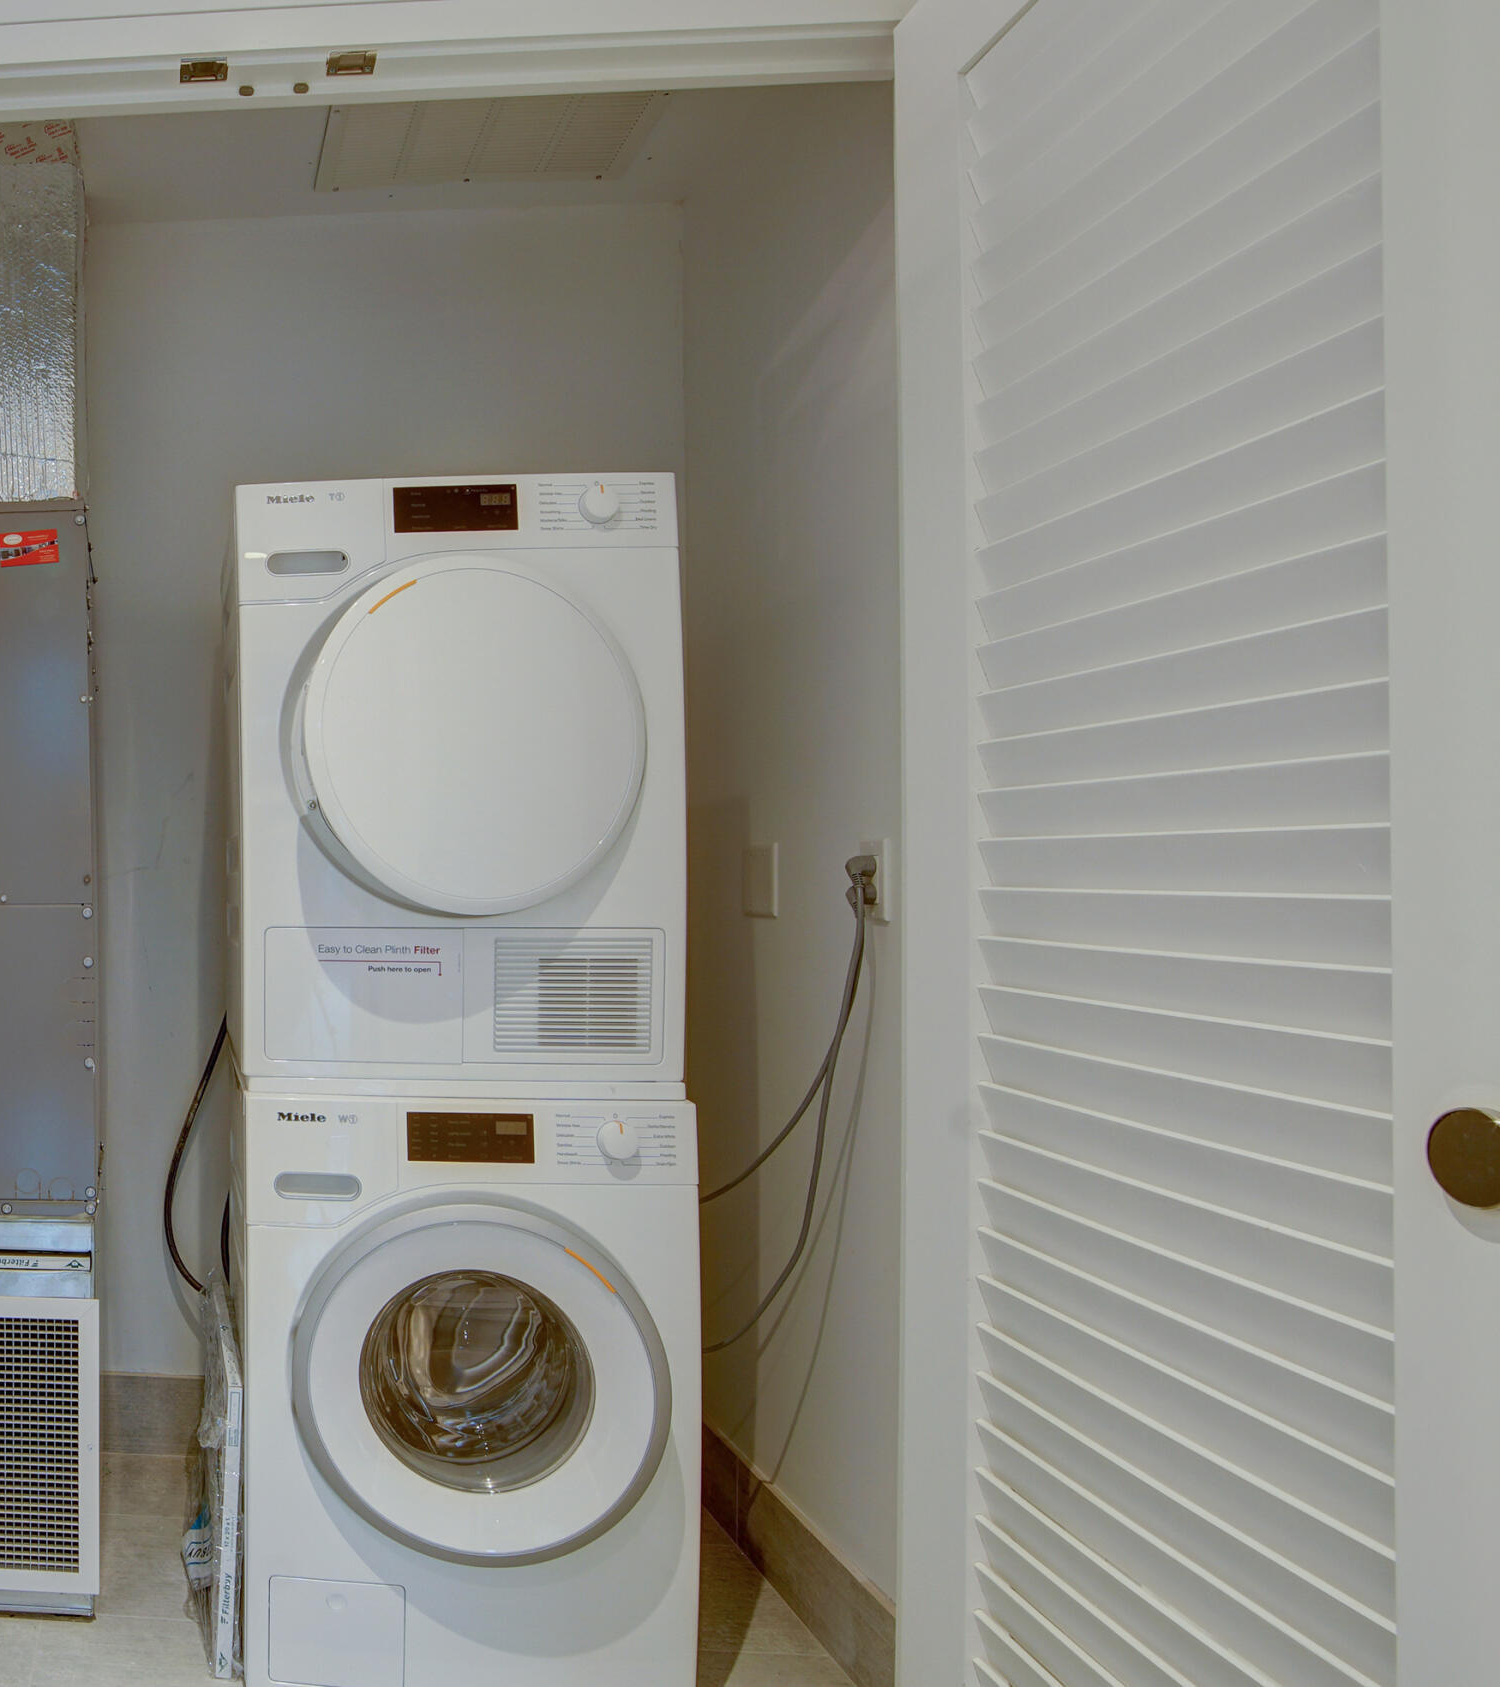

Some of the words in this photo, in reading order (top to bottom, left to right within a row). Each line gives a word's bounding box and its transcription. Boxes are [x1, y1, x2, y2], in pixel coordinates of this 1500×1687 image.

[266, 494, 315, 504] Miele
[318, 945, 341, 955] Easy
[342, 945, 353, 954] to
[355, 944, 383, 954] Clean
[384, 944, 412, 955] Plinth
[413, 945, 441, 955] Filter
[367, 965, 386, 973] Push
[387, 965, 403, 973] here
[276, 1111, 327, 1123] Miele
[221, 1572, 232, 1615] Filterbuy
